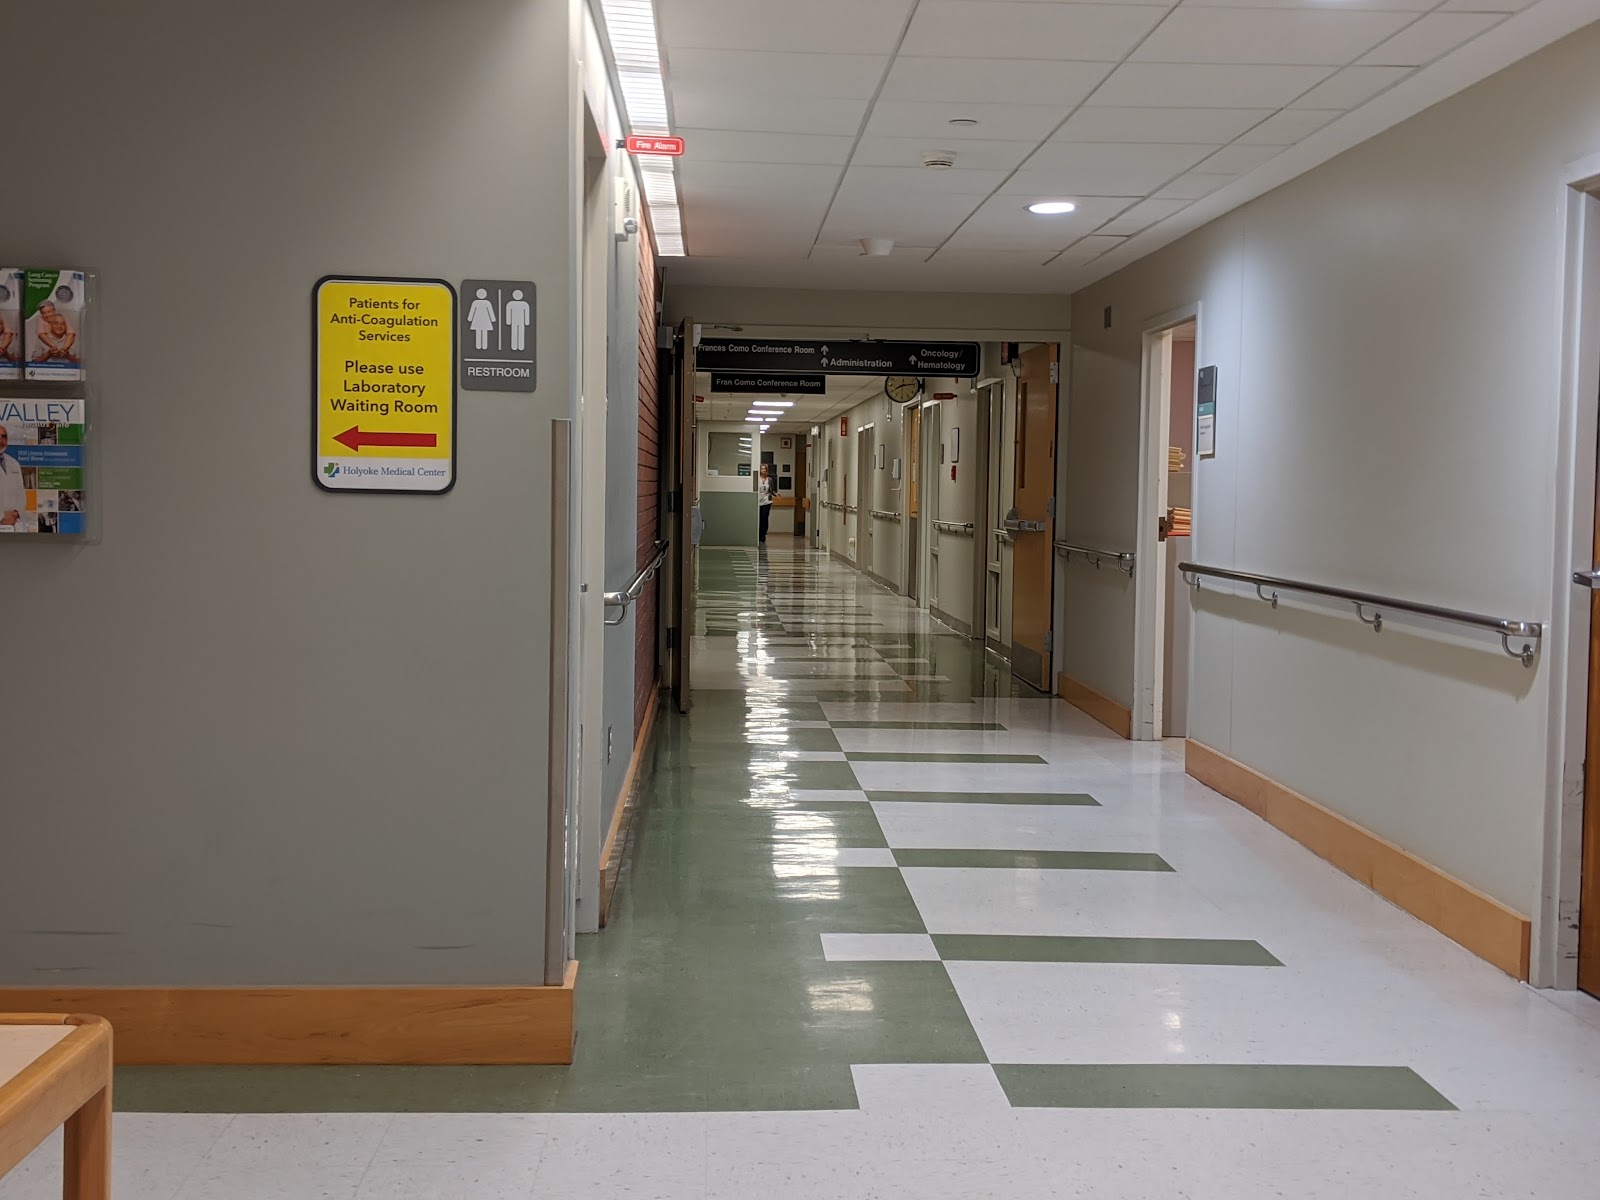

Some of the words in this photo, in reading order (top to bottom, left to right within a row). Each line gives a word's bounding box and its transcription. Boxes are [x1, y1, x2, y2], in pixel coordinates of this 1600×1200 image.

[636, 140, 652, 149] Fire
[653, 141, 677, 151] Alarm
[349, 297, 399, 310] Patients
[402, 298, 421, 310] for
[330, 313, 438, 329] Anti-Coagulation
[358, 330, 411, 342] Services
[698, 344, 726, 352] Frances
[728, 344, 749, 353] Como
[751, 345, 792, 354] Conference
[794, 346, 815, 354] Room
[345, 360, 394, 374] Please
[398, 365, 424, 375] use
[830, 358, 892, 368] Administration
[918, 361, 965, 370] Hematology
[467, 367, 530, 378] RESTROOM
[757, 379, 798, 387] Conference
[343, 380, 426, 398] Laboratory
[330, 399, 389, 416] Waiting
[394, 400, 438, 413] Room
[343, 466, 378, 477] Holyoke
[381, 466, 415, 476] Medical
[417, 467, 446, 477] Center
